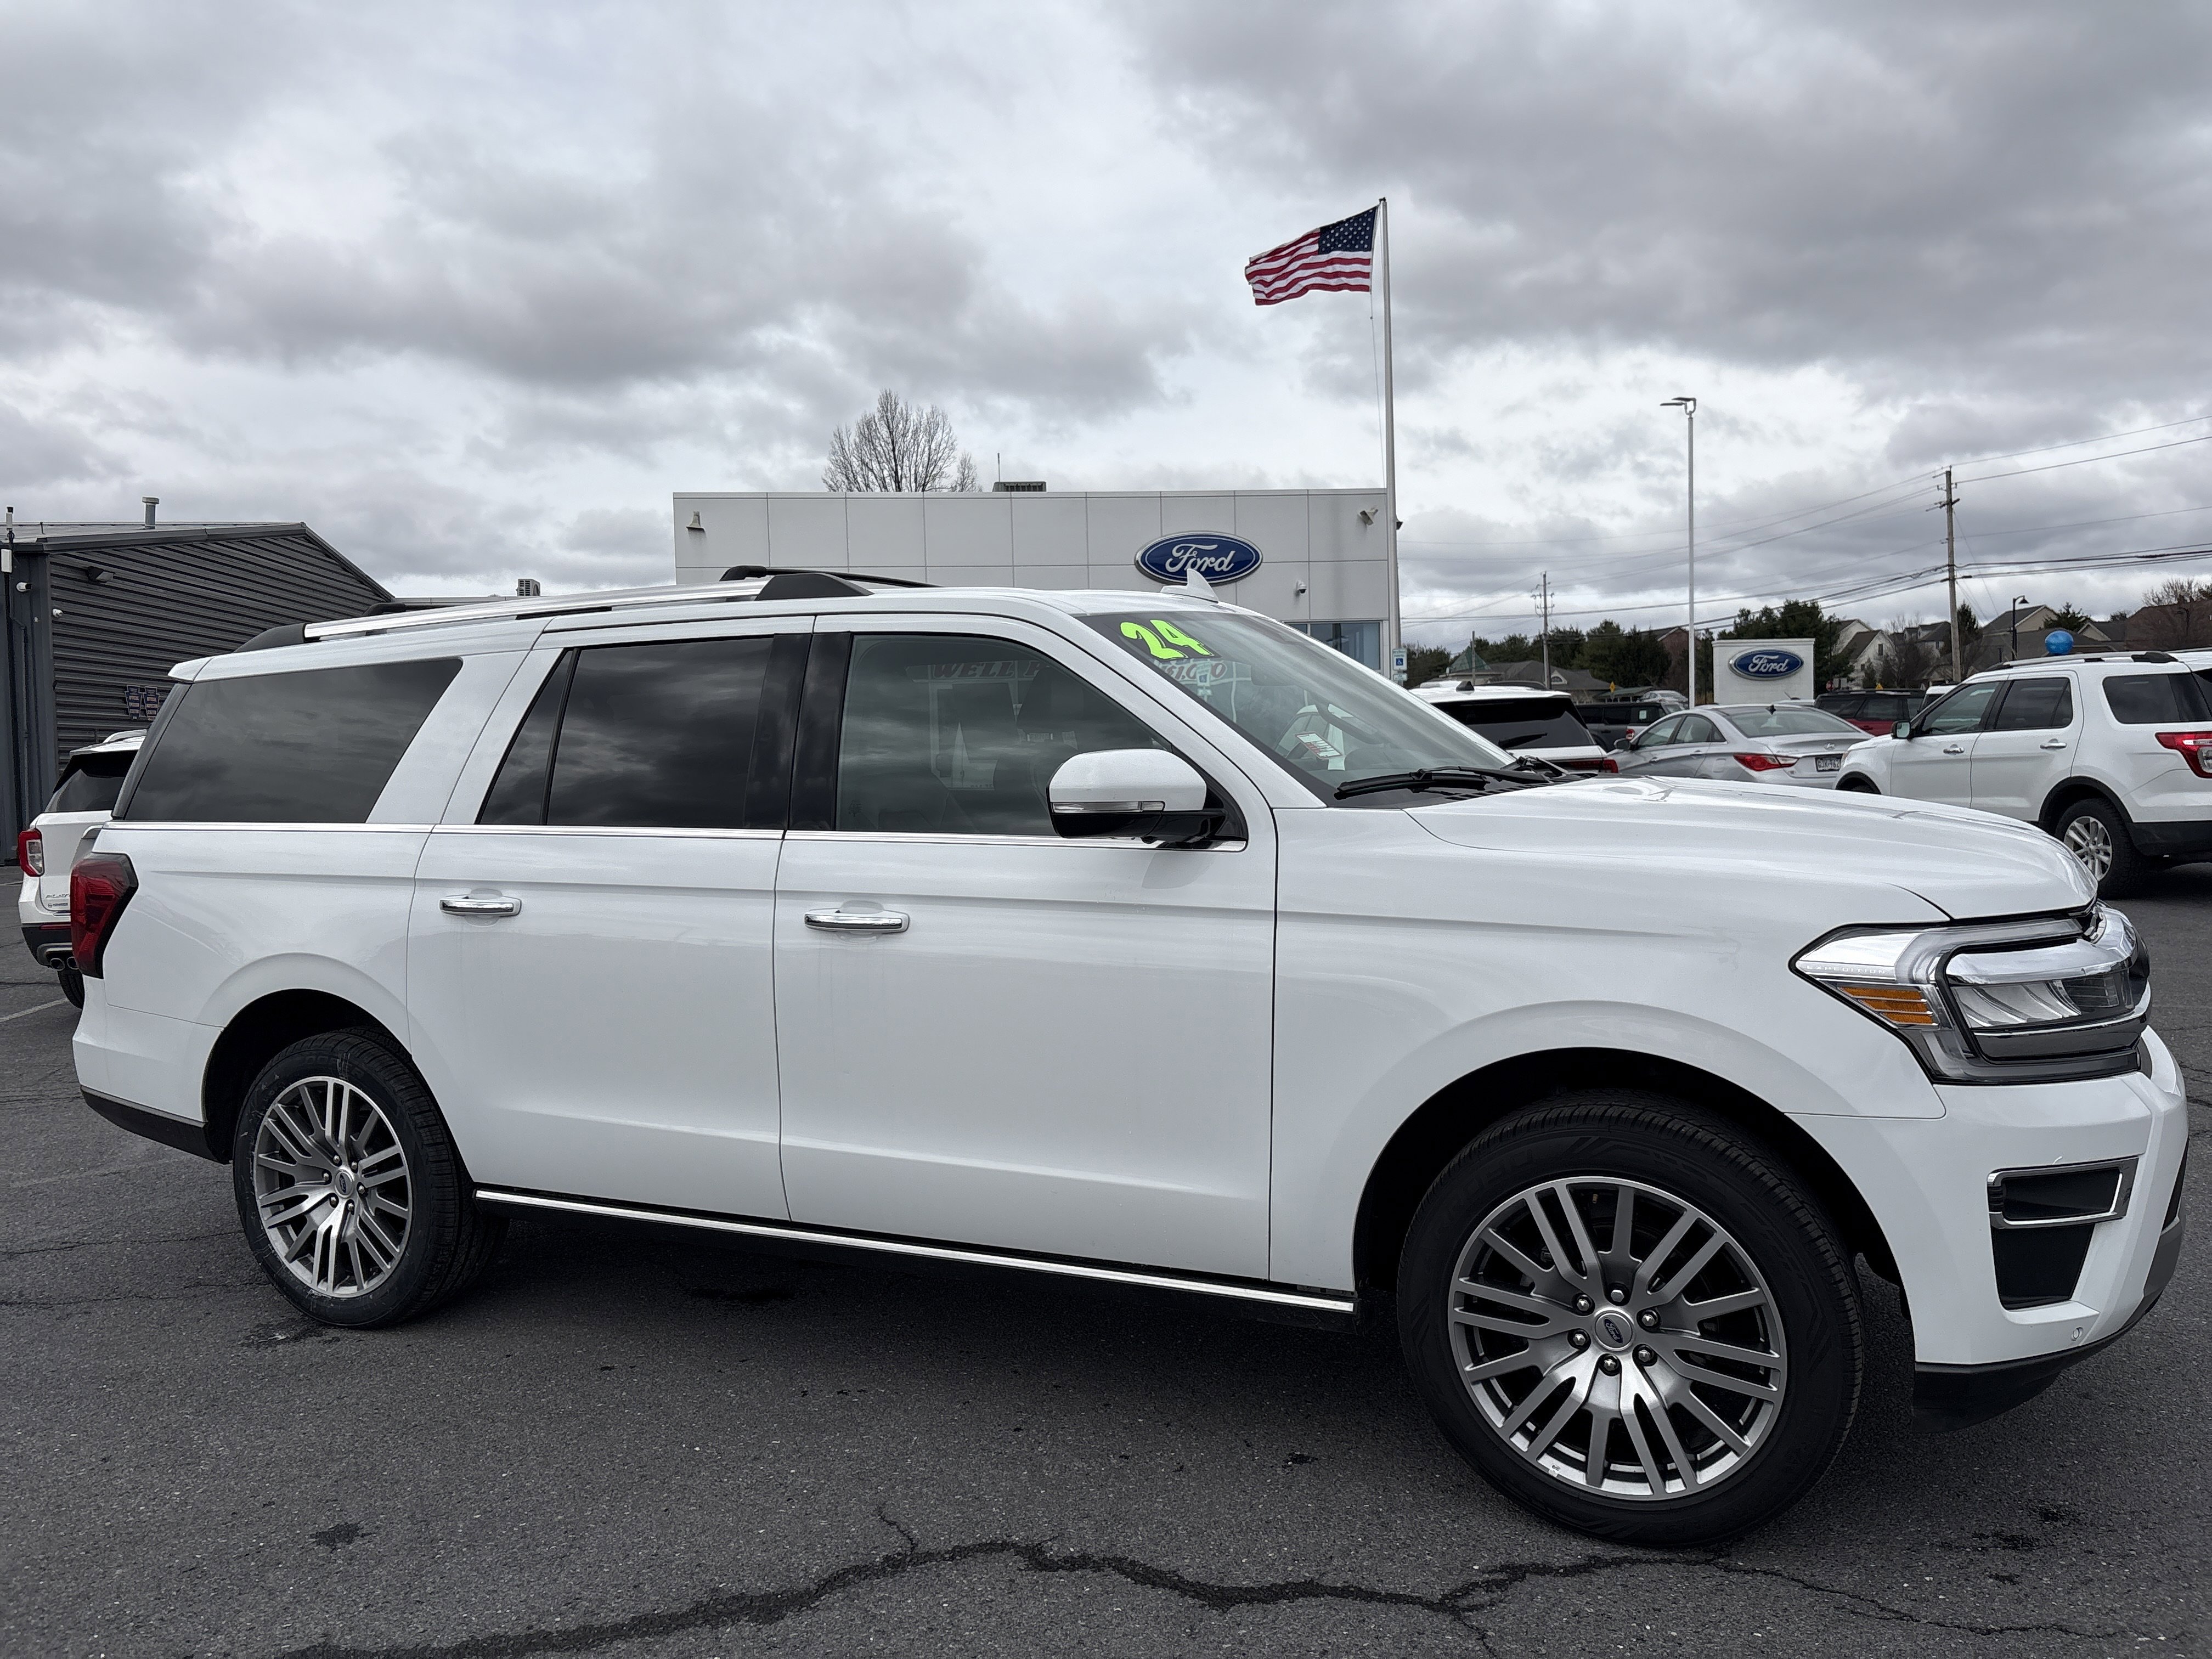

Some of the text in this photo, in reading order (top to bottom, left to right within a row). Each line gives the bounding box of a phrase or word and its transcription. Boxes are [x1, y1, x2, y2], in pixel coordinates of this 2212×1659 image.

[1165, 543, 1236, 572] Ford
[1120, 619, 1215, 659] 24
[1748, 654, 1788, 672] Ford
[1605, 1322, 1621, 1340] Ford
